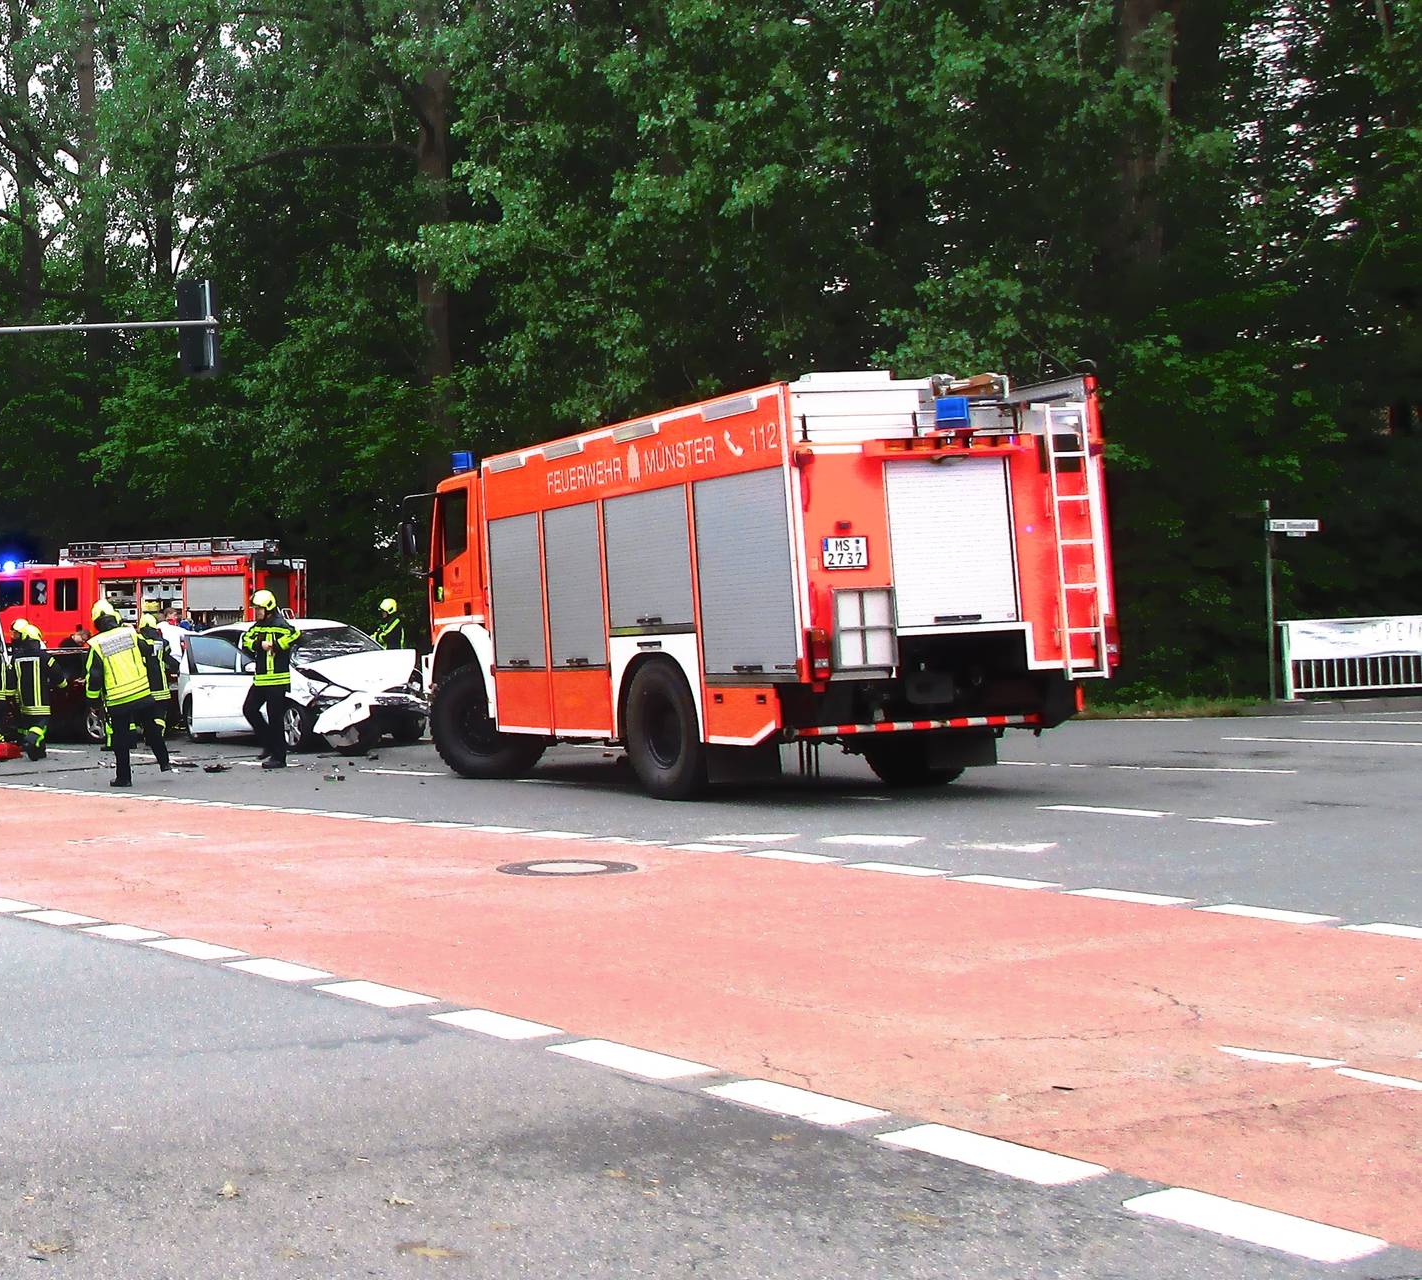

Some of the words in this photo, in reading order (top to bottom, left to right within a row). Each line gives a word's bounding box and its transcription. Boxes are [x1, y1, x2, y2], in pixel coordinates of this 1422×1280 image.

[546, 456, 623, 495] FEUERWEHR
[644, 437, 716, 473] MÜNSTER
[750, 422, 778, 452] 112
[835, 539, 850, 551] MS
[828, 552, 862, 565] 2737
[146, 566, 184, 575] FEUERWEHR
[227, 564, 239, 572] 112
